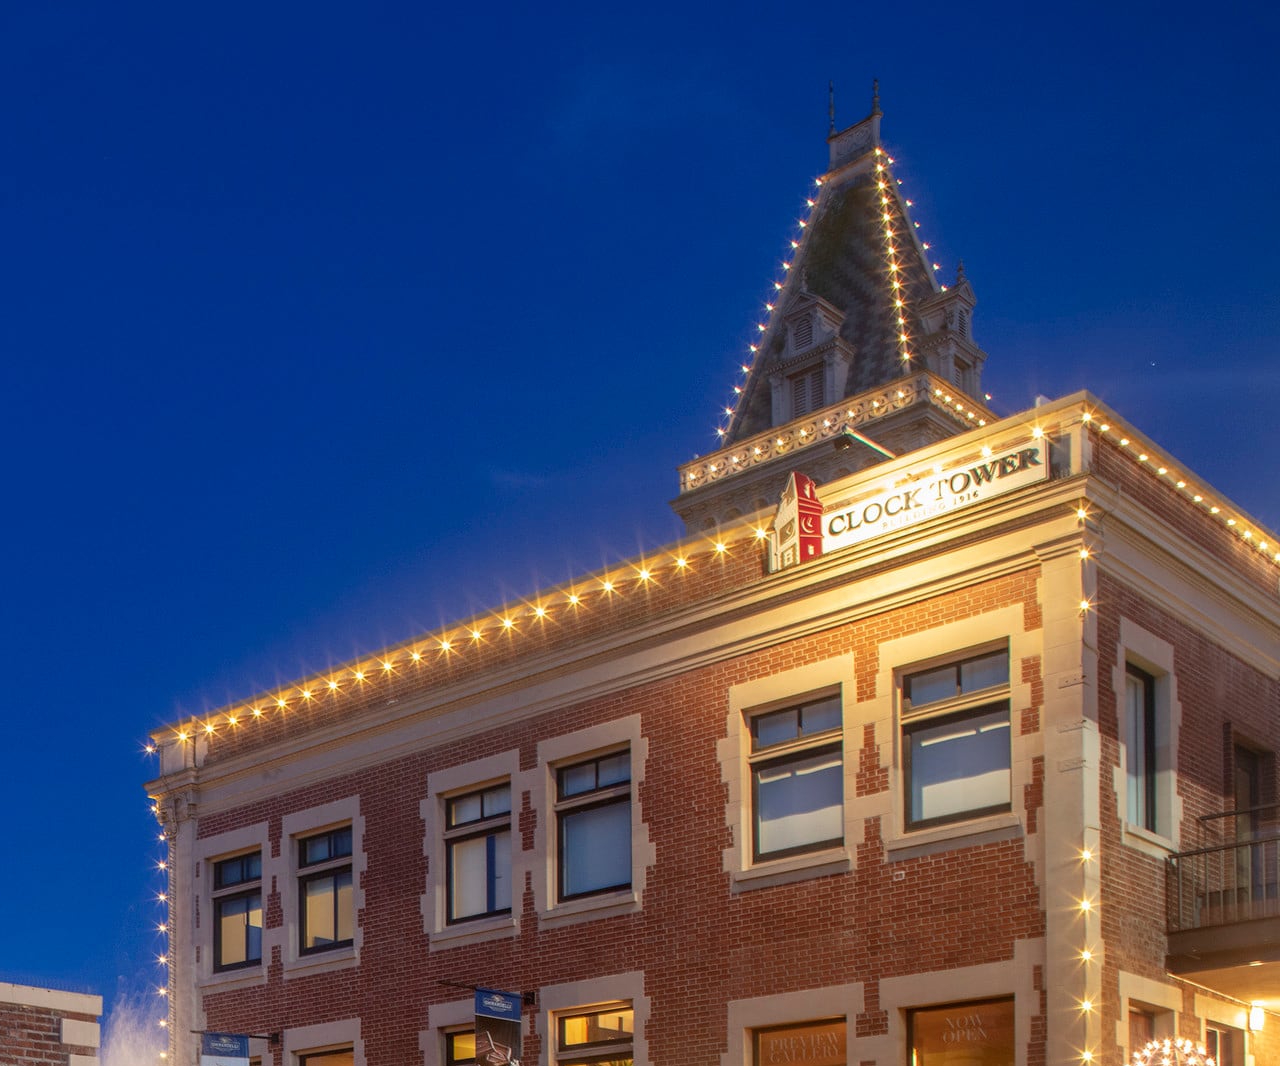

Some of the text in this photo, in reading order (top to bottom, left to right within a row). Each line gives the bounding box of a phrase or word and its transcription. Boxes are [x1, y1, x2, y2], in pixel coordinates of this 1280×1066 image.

[828, 447, 1043, 537] CLOCK TOWER
[952, 490, 980, 506] 1916
[770, 1032, 840, 1052] PREVIEW
[770, 1045, 840, 1063] GALLERY
